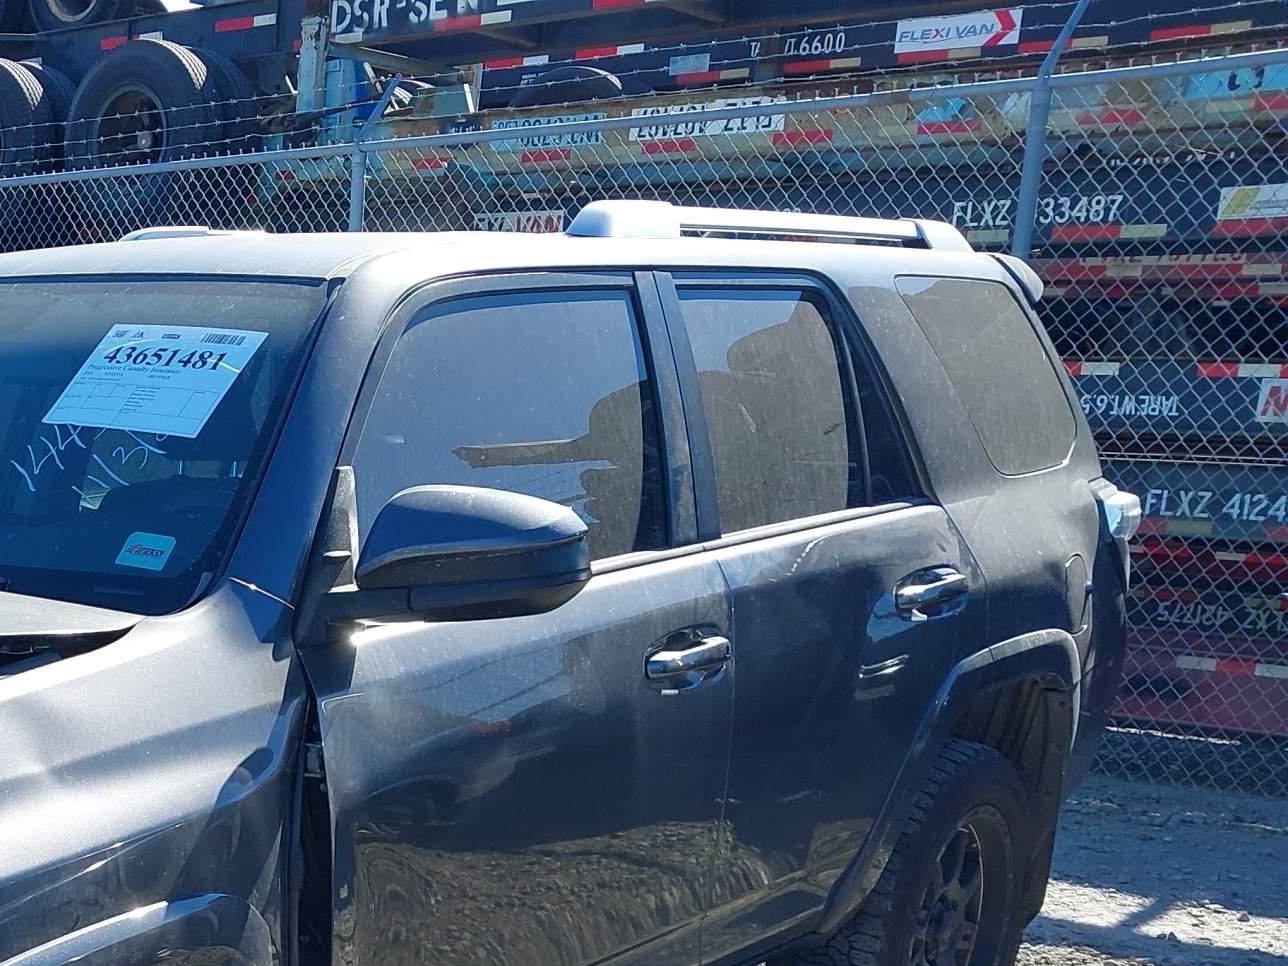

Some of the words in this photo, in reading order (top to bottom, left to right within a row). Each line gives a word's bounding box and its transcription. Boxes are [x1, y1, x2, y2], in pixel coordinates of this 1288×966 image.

[898, 26, 952, 43] FLEXI
[955, 23, 996, 39] VAN
[952, 199, 1012, 227] FLXZ
[1033, 194, 1125, 225] 33487
[104, 345, 228, 371] 43651481
[1144, 489, 1214, 518] FLXZ
